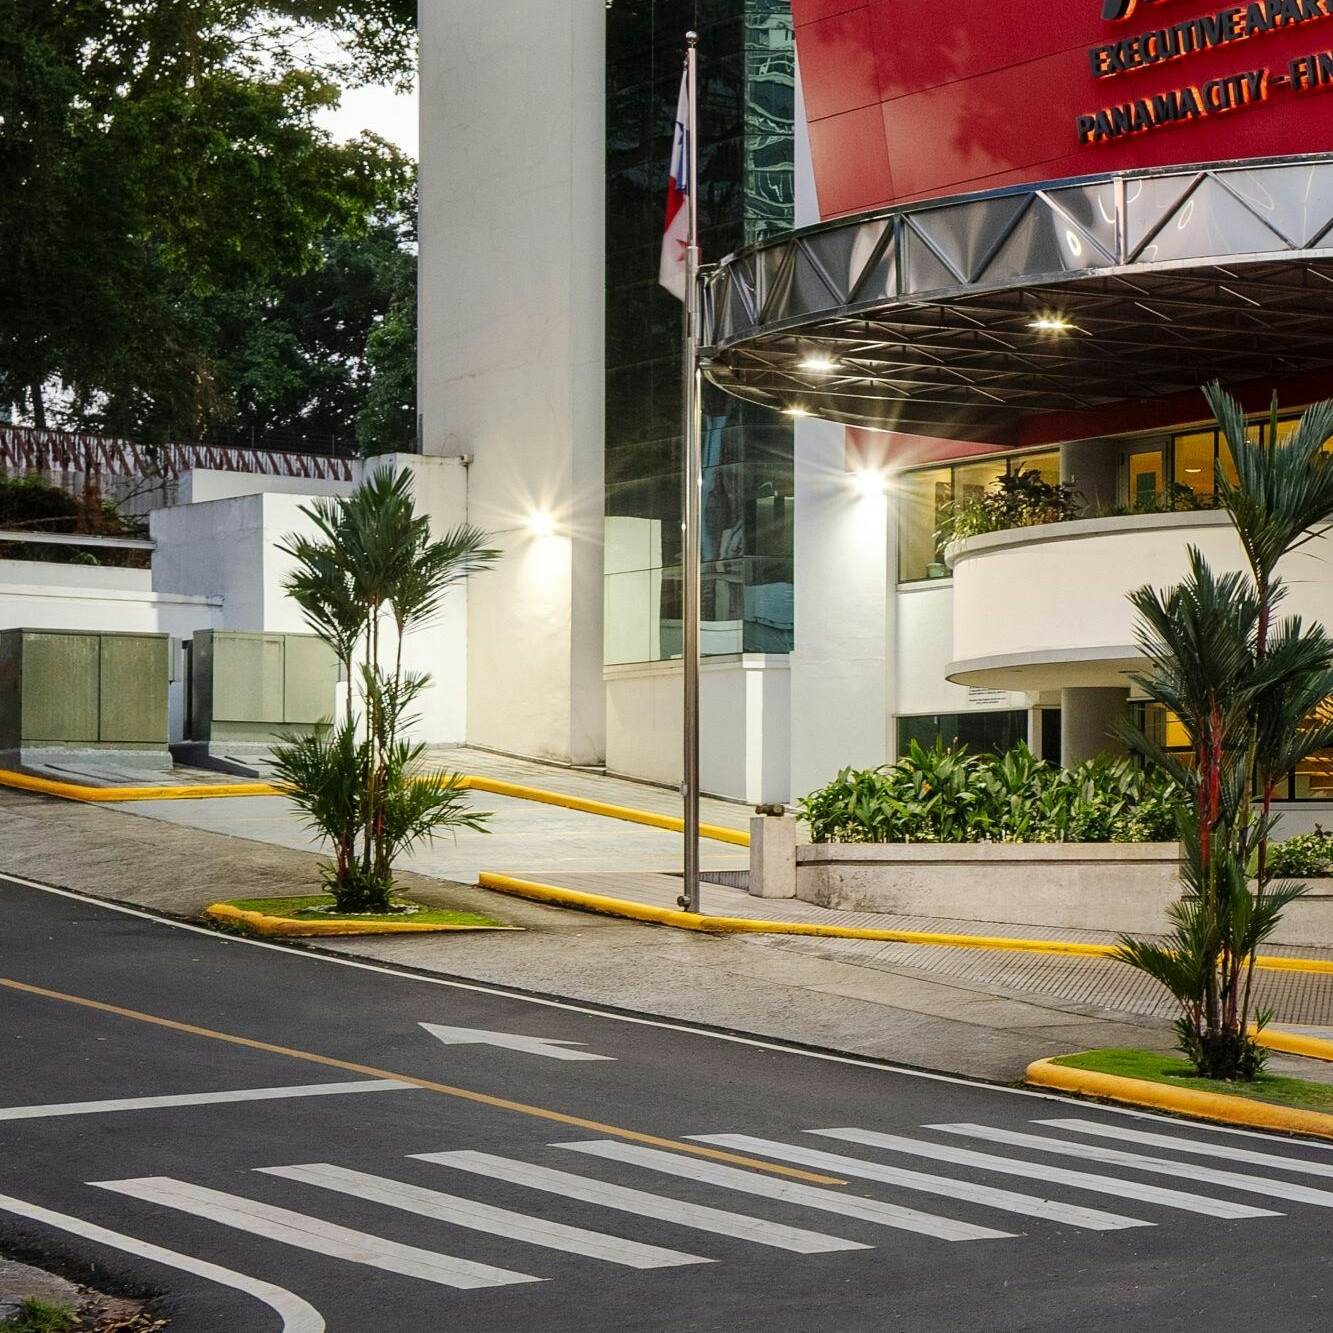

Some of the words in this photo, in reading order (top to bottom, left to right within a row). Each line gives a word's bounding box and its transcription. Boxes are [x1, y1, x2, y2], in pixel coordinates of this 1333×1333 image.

[1089, 6, 1247, 78] EXECUTIVE
[1075, 85, 1206, 146] PANAMA
[1202, 68, 1269, 112] CITY
